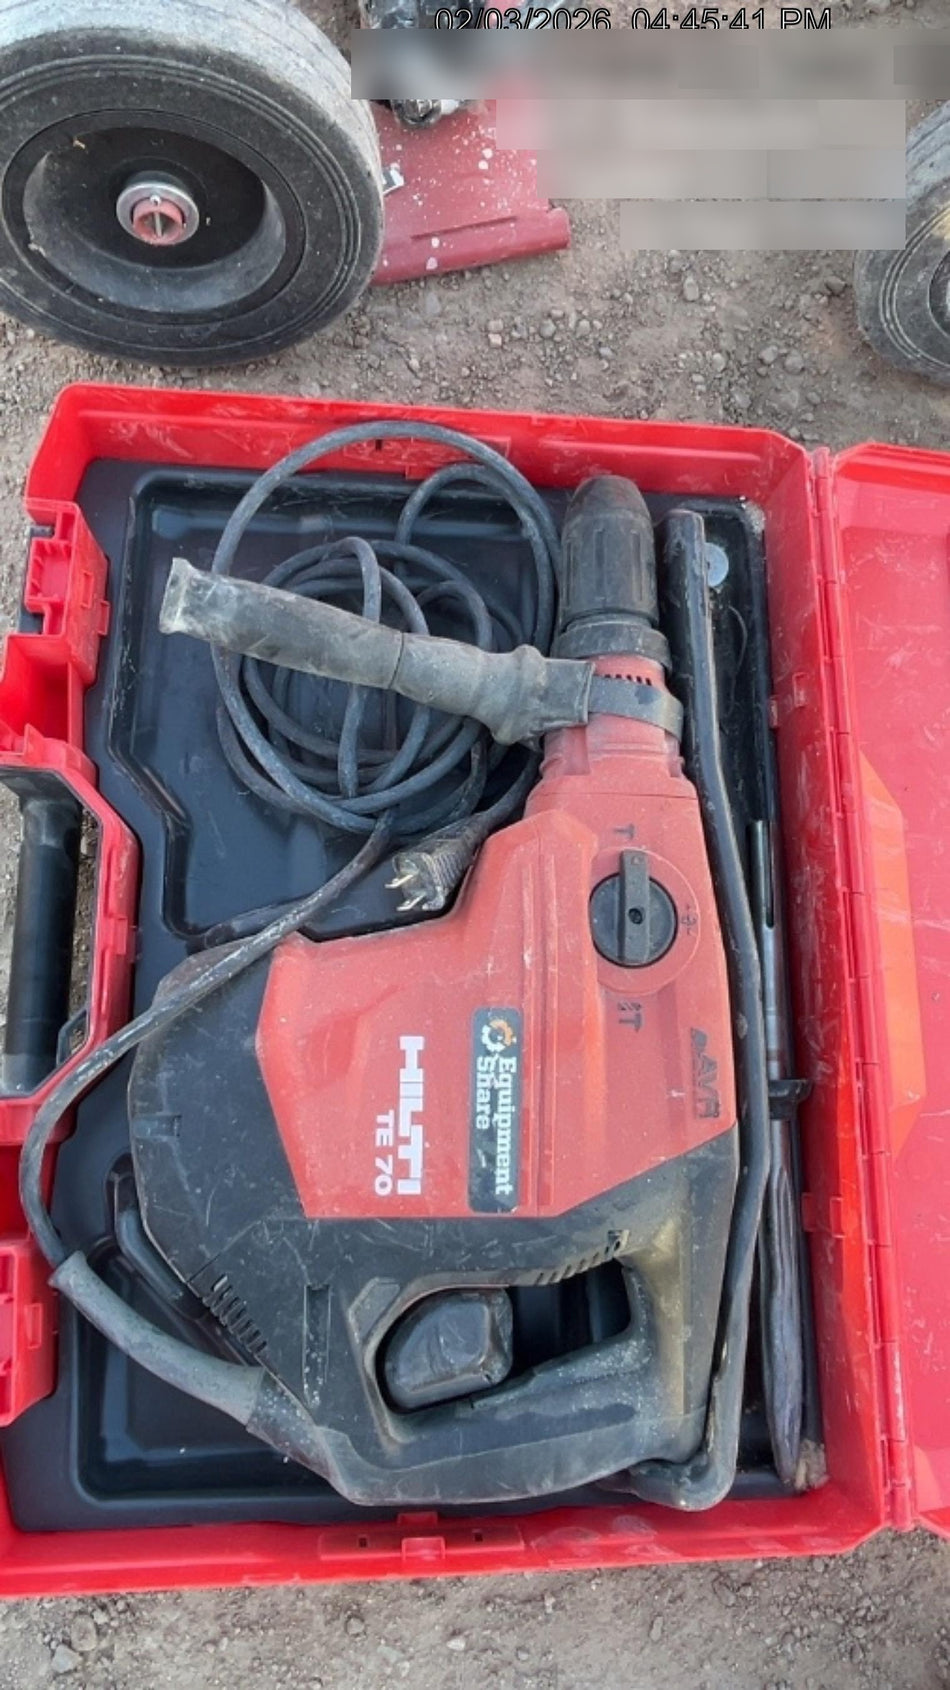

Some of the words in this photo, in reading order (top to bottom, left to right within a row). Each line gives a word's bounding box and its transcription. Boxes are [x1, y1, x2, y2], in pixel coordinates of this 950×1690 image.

[375, 1109, 395, 1147] TE
[397, 1036, 424, 1195] HILTI
[476, 1056, 496, 1130] Share
[493, 1056, 517, 1196] Equipment
[374, 1154, 394, 1196] 70
